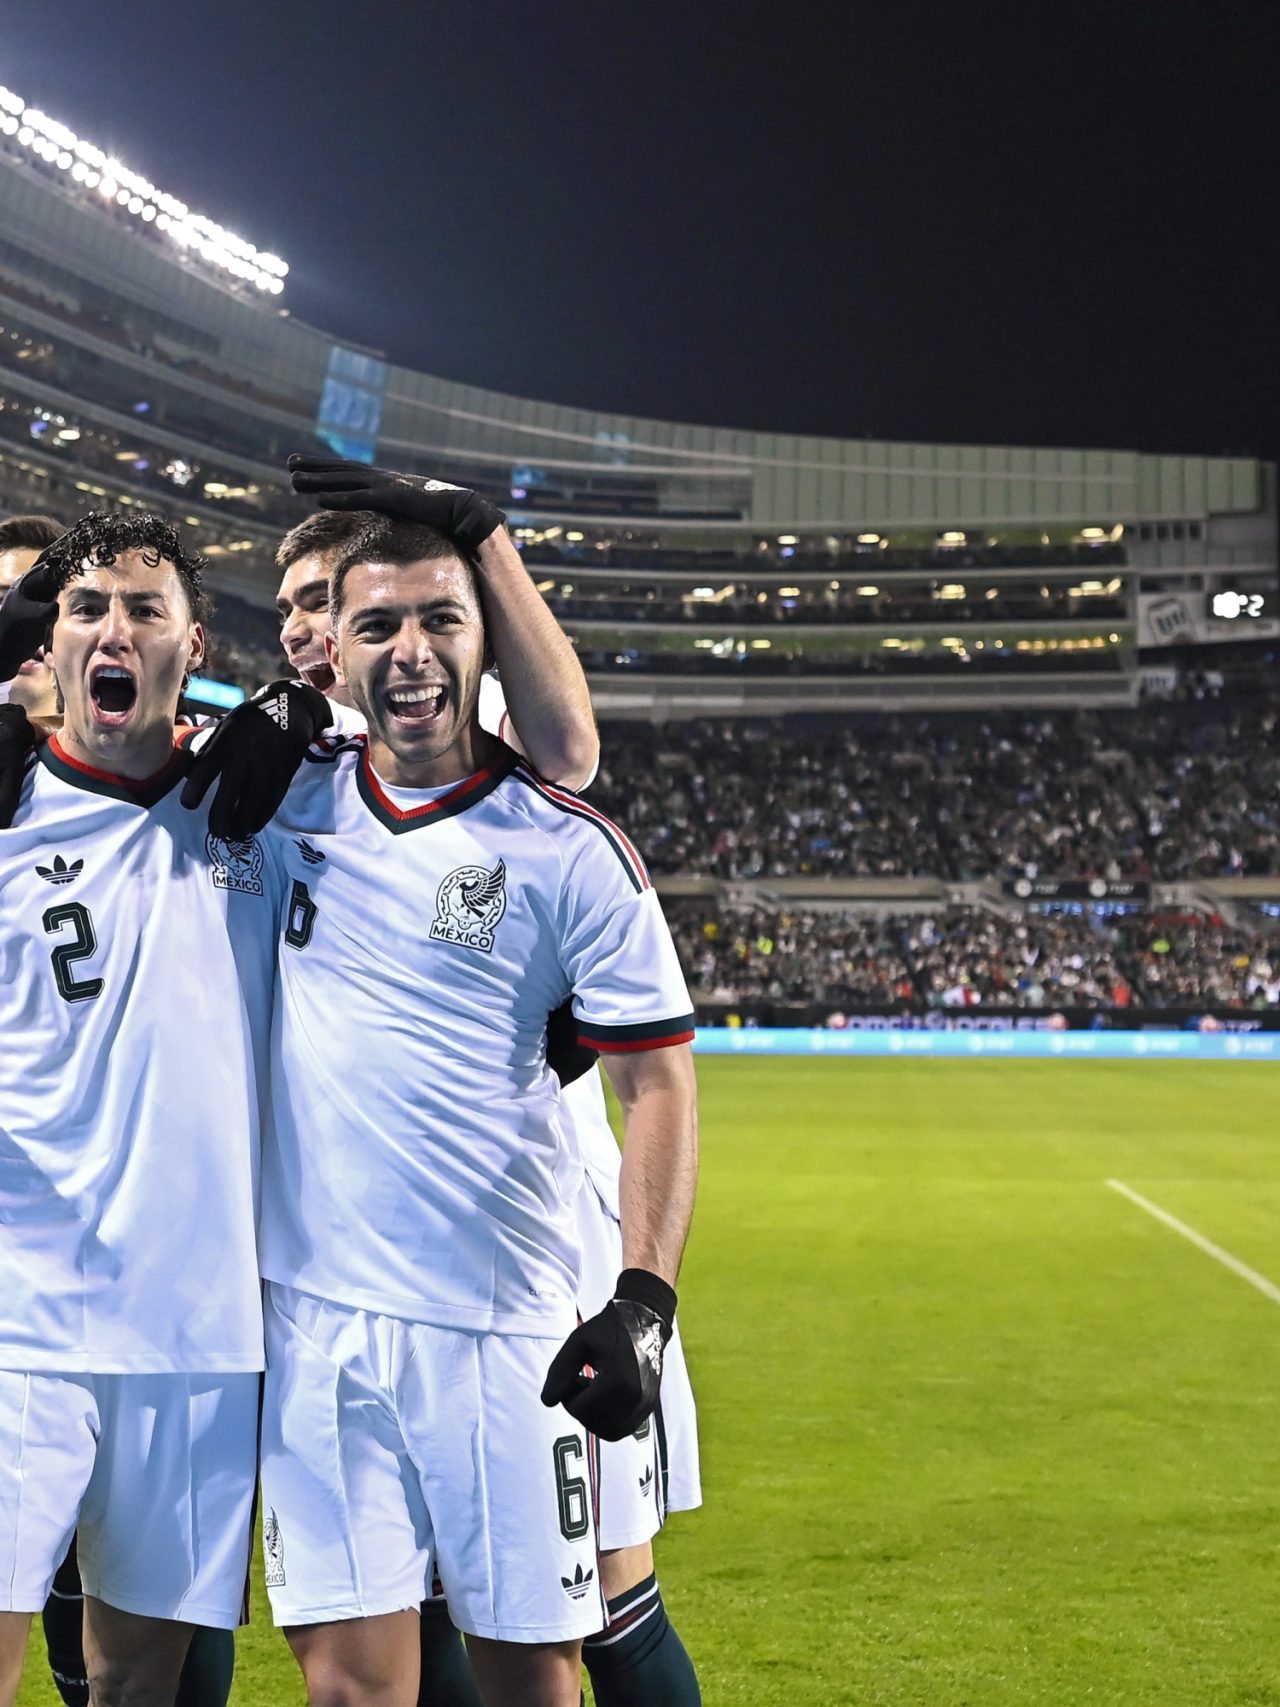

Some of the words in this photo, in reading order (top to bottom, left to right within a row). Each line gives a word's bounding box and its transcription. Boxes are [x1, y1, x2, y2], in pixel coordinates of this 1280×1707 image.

[279, 691, 289, 731] adidas
[215, 874, 261, 892] MÉXICO
[41, 901, 104, 1003] 2
[433, 924, 490, 949] MÉXICO
[553, 1434, 589, 1543] 6
